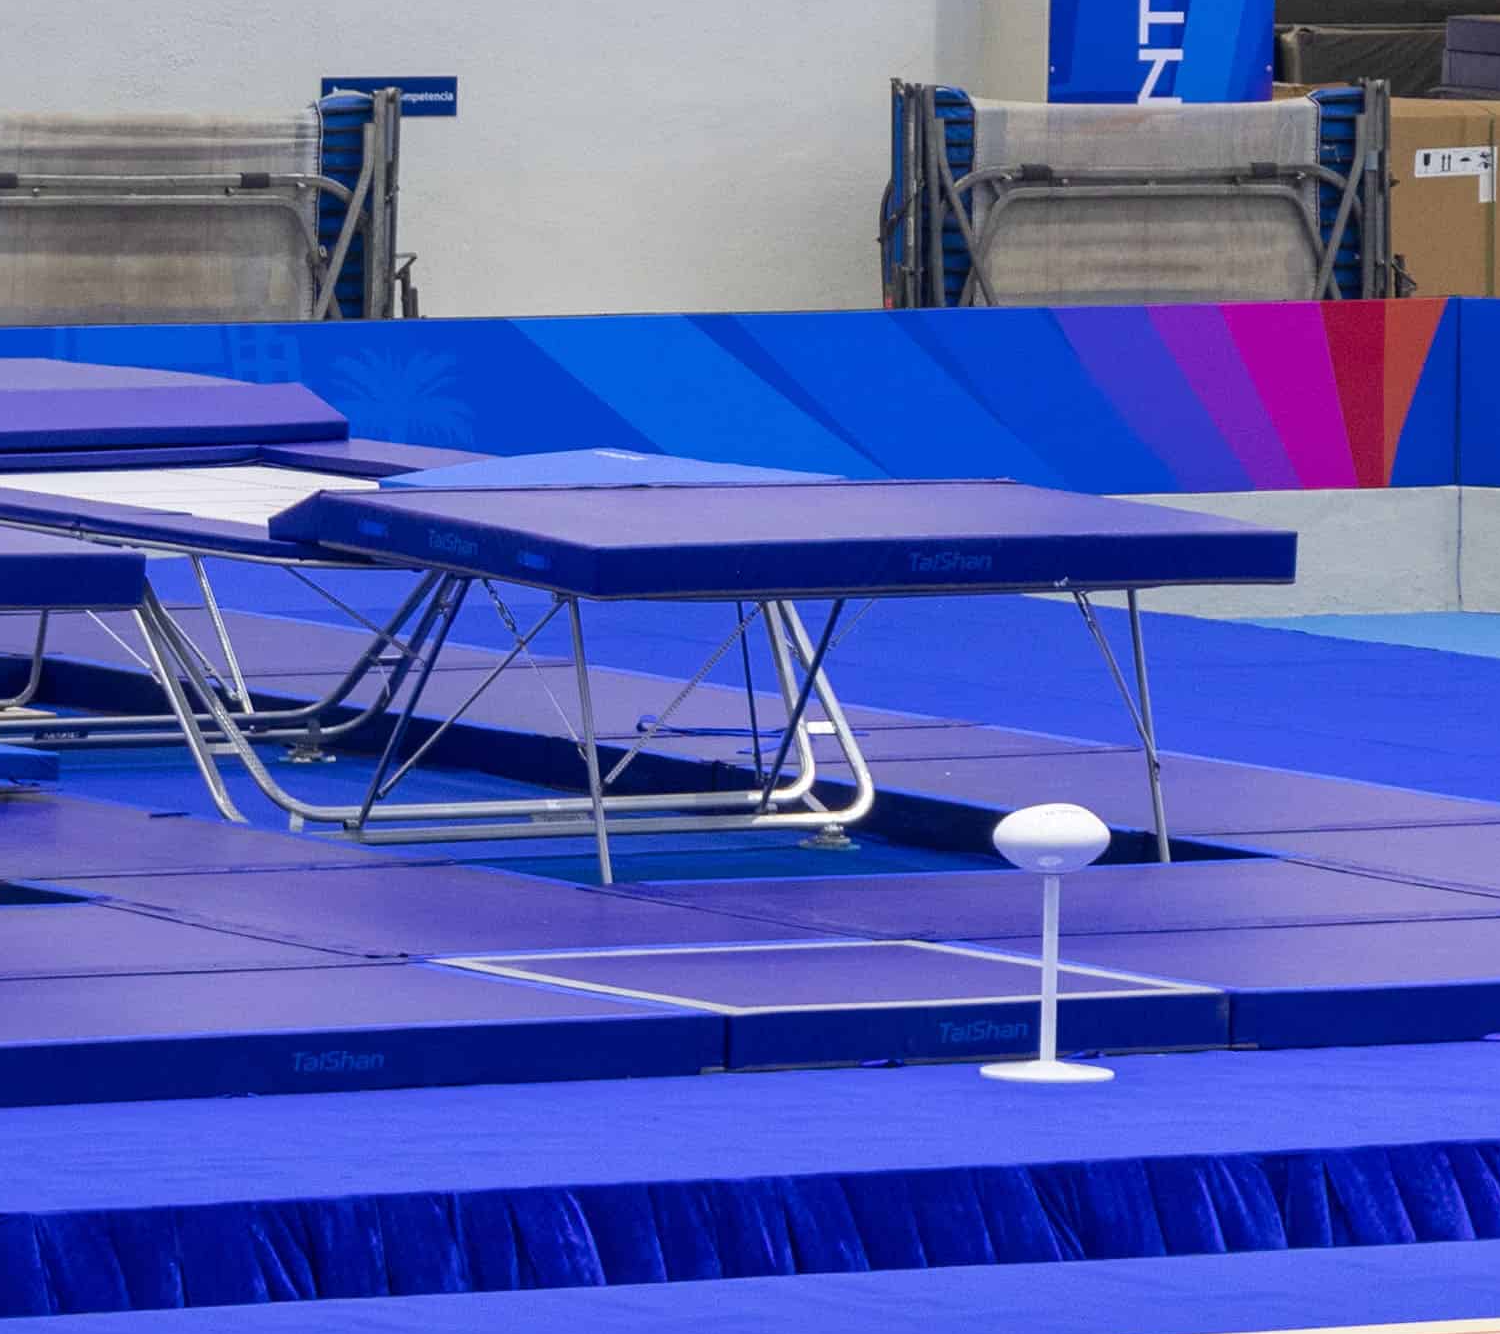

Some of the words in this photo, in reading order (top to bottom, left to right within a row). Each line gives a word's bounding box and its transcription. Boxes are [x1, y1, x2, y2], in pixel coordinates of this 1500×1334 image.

[906, 551, 993, 573] TaiShan
[938, 1021, 1029, 1045] TaiShan
[289, 1050, 386, 1075] TaiShan
